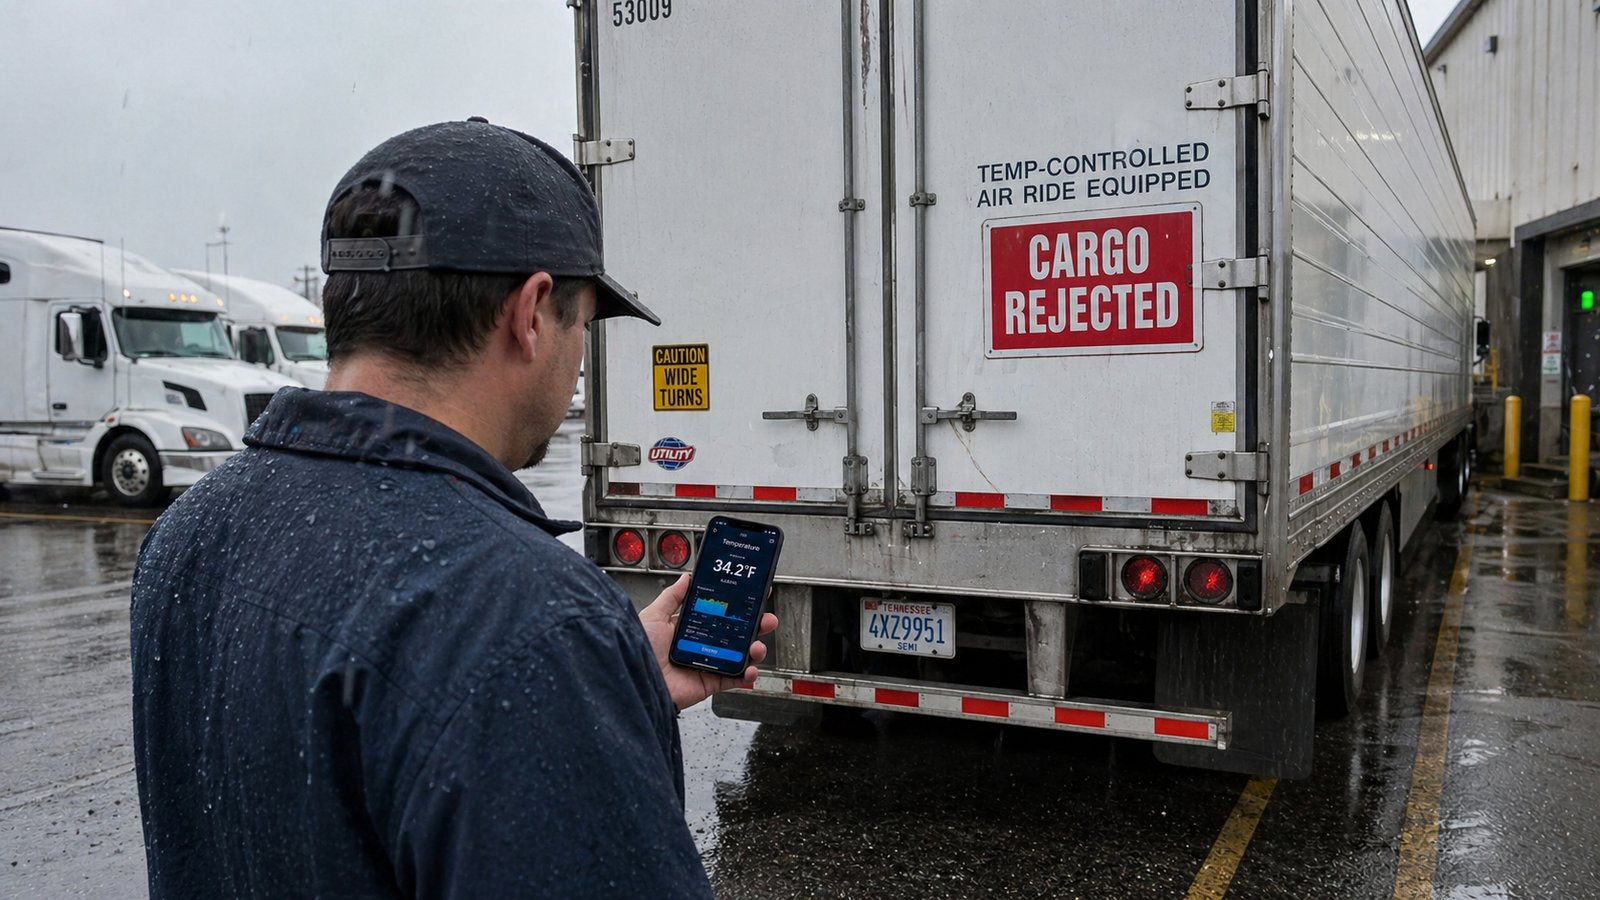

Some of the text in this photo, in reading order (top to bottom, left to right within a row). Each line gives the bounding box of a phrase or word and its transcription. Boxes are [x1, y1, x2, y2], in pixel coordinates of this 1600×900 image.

[613, 0, 672, 27] 53009
[977, 142, 1210, 183] TEMP-CONTROLLED
[976, 168, 1211, 208] AIR RIDE EQUIPPED
[1029, 226, 1150, 281] CARGO
[1005, 281, 1179, 335] REJECTED
[655, 347, 706, 364] CAUTION
[664, 367, 698, 386] WIDE
[660, 388, 703, 407] TURNS
[650, 448, 693, 460] UTILITY
[722, 538, 761, 552] Temperature
[712, 558, 757, 579] 34.2°F
[869, 613, 945, 644] 4XZ9951
[897, 641, 918, 652] SEMI
